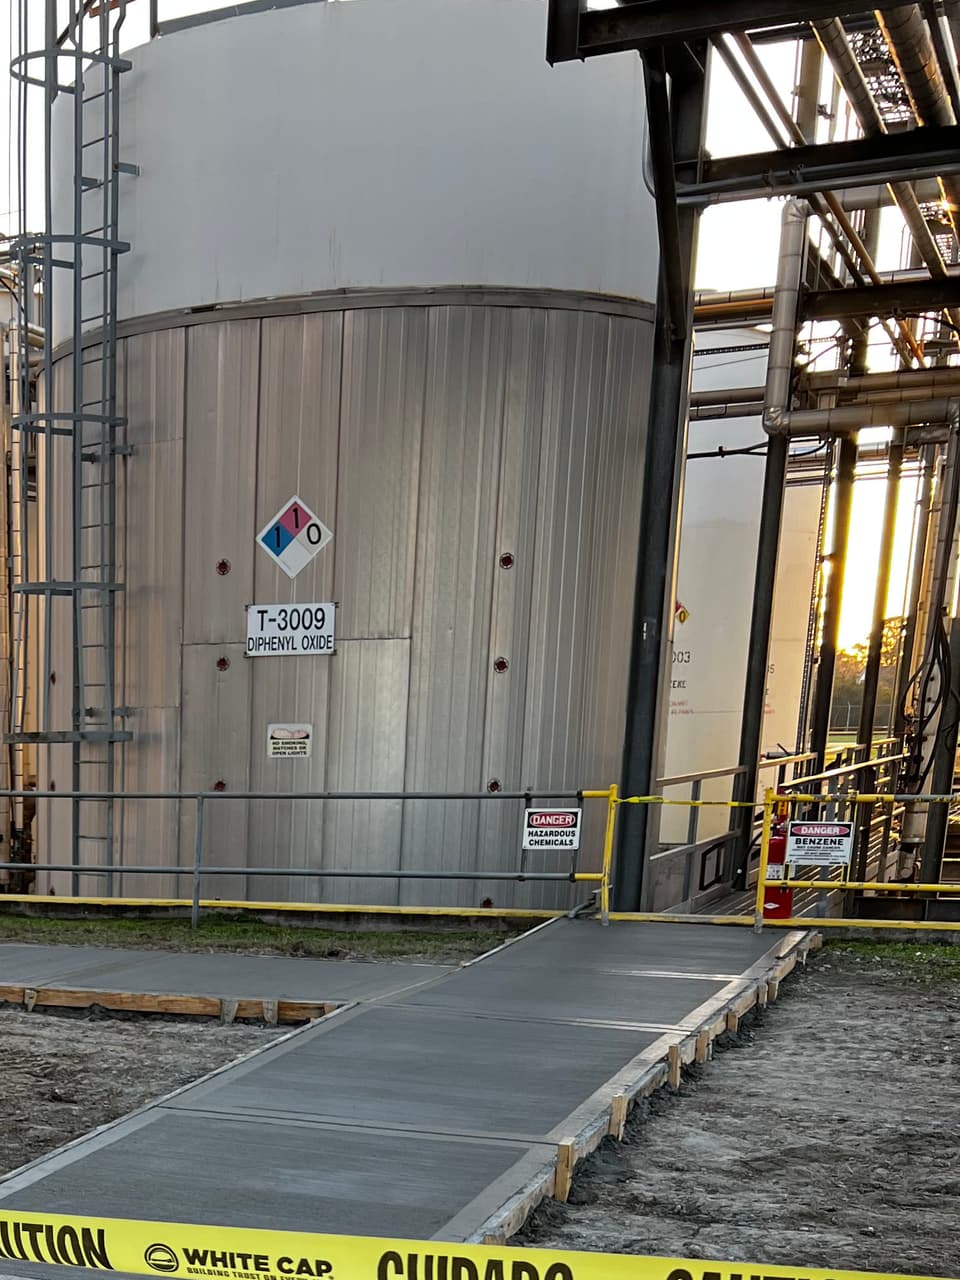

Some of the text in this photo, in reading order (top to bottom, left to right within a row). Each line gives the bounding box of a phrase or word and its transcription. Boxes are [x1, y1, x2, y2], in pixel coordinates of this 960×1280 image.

[292, 507, 299, 529] 1
[275, 523, 321, 548] 1 0
[257, 607, 325, 631] T-3009
[247, 635, 333, 652] DIPHENYL OXIDE
[533, 815, 573, 825] DANGER
[800, 826, 840, 834] DANGER
[182, 1248, 333, 1277] WHITE CAP
[186, 1267, 230, 1277] BUILDING
[232, 1271, 260, 1280] TRUST
